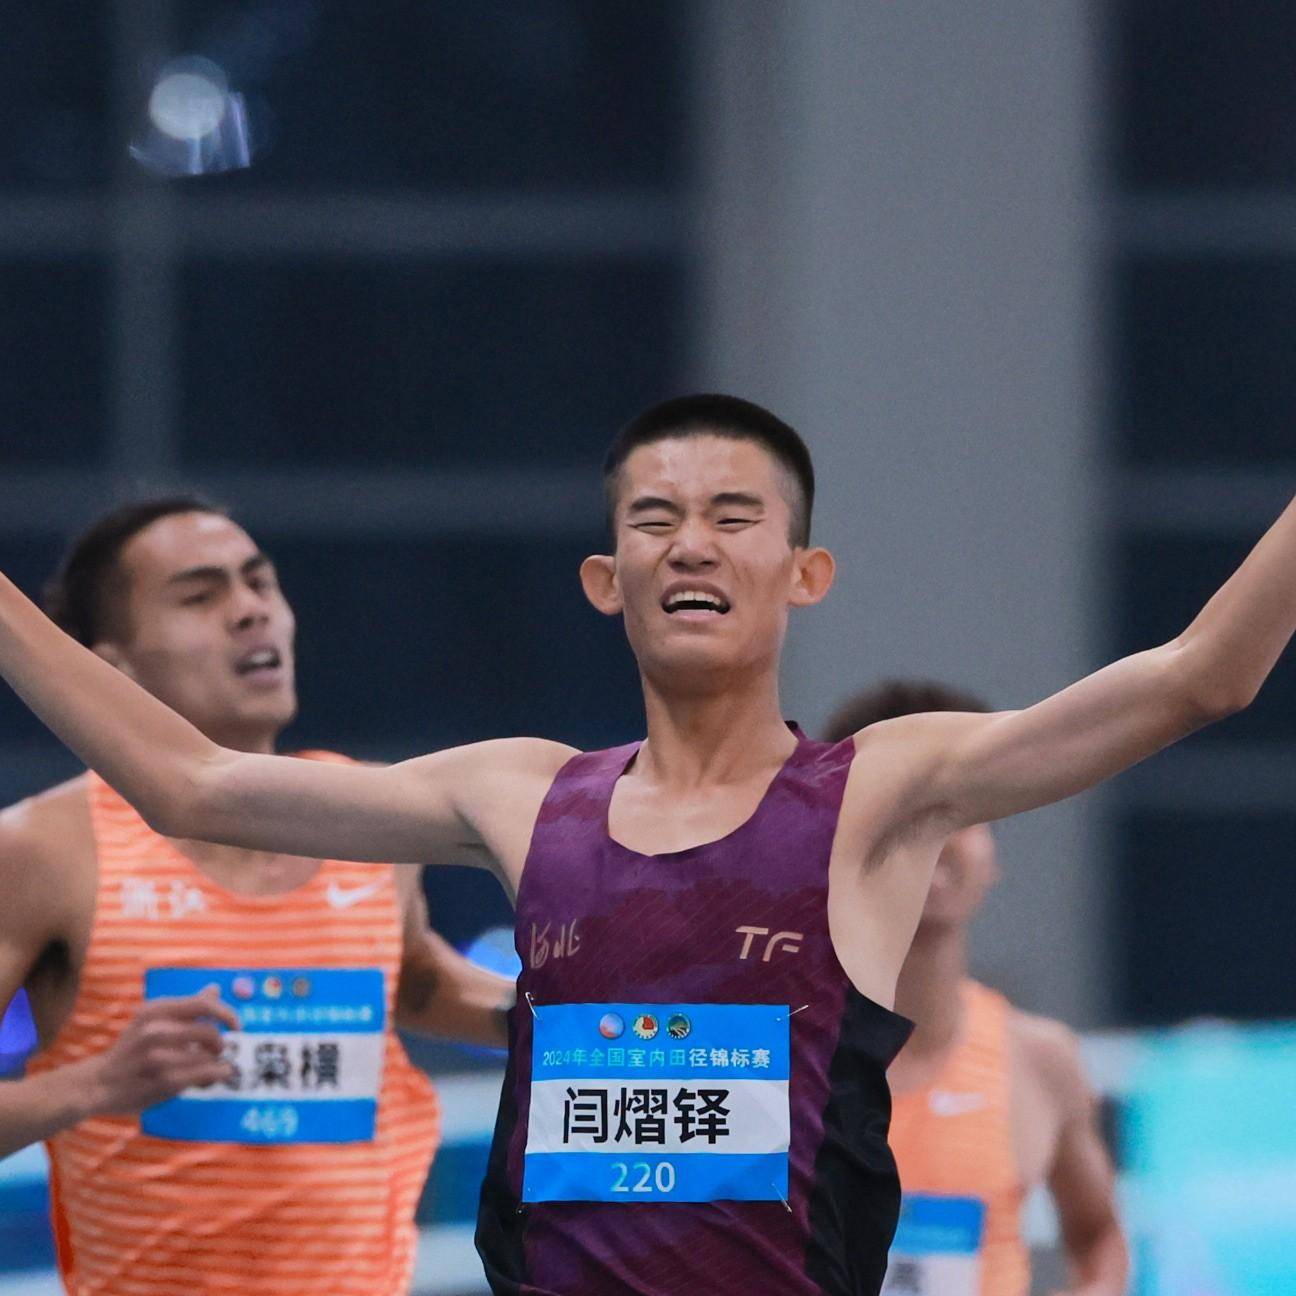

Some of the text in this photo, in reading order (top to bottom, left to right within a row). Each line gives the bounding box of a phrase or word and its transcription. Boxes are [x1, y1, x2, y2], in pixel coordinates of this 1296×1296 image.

[735, 925, 804, 962] TF
[542, 1047, 771, 1069] 2024年全国室内田径锦标赛
[562, 1086, 731, 1145] 闫熠铎
[610, 1161, 677, 1193] 220
